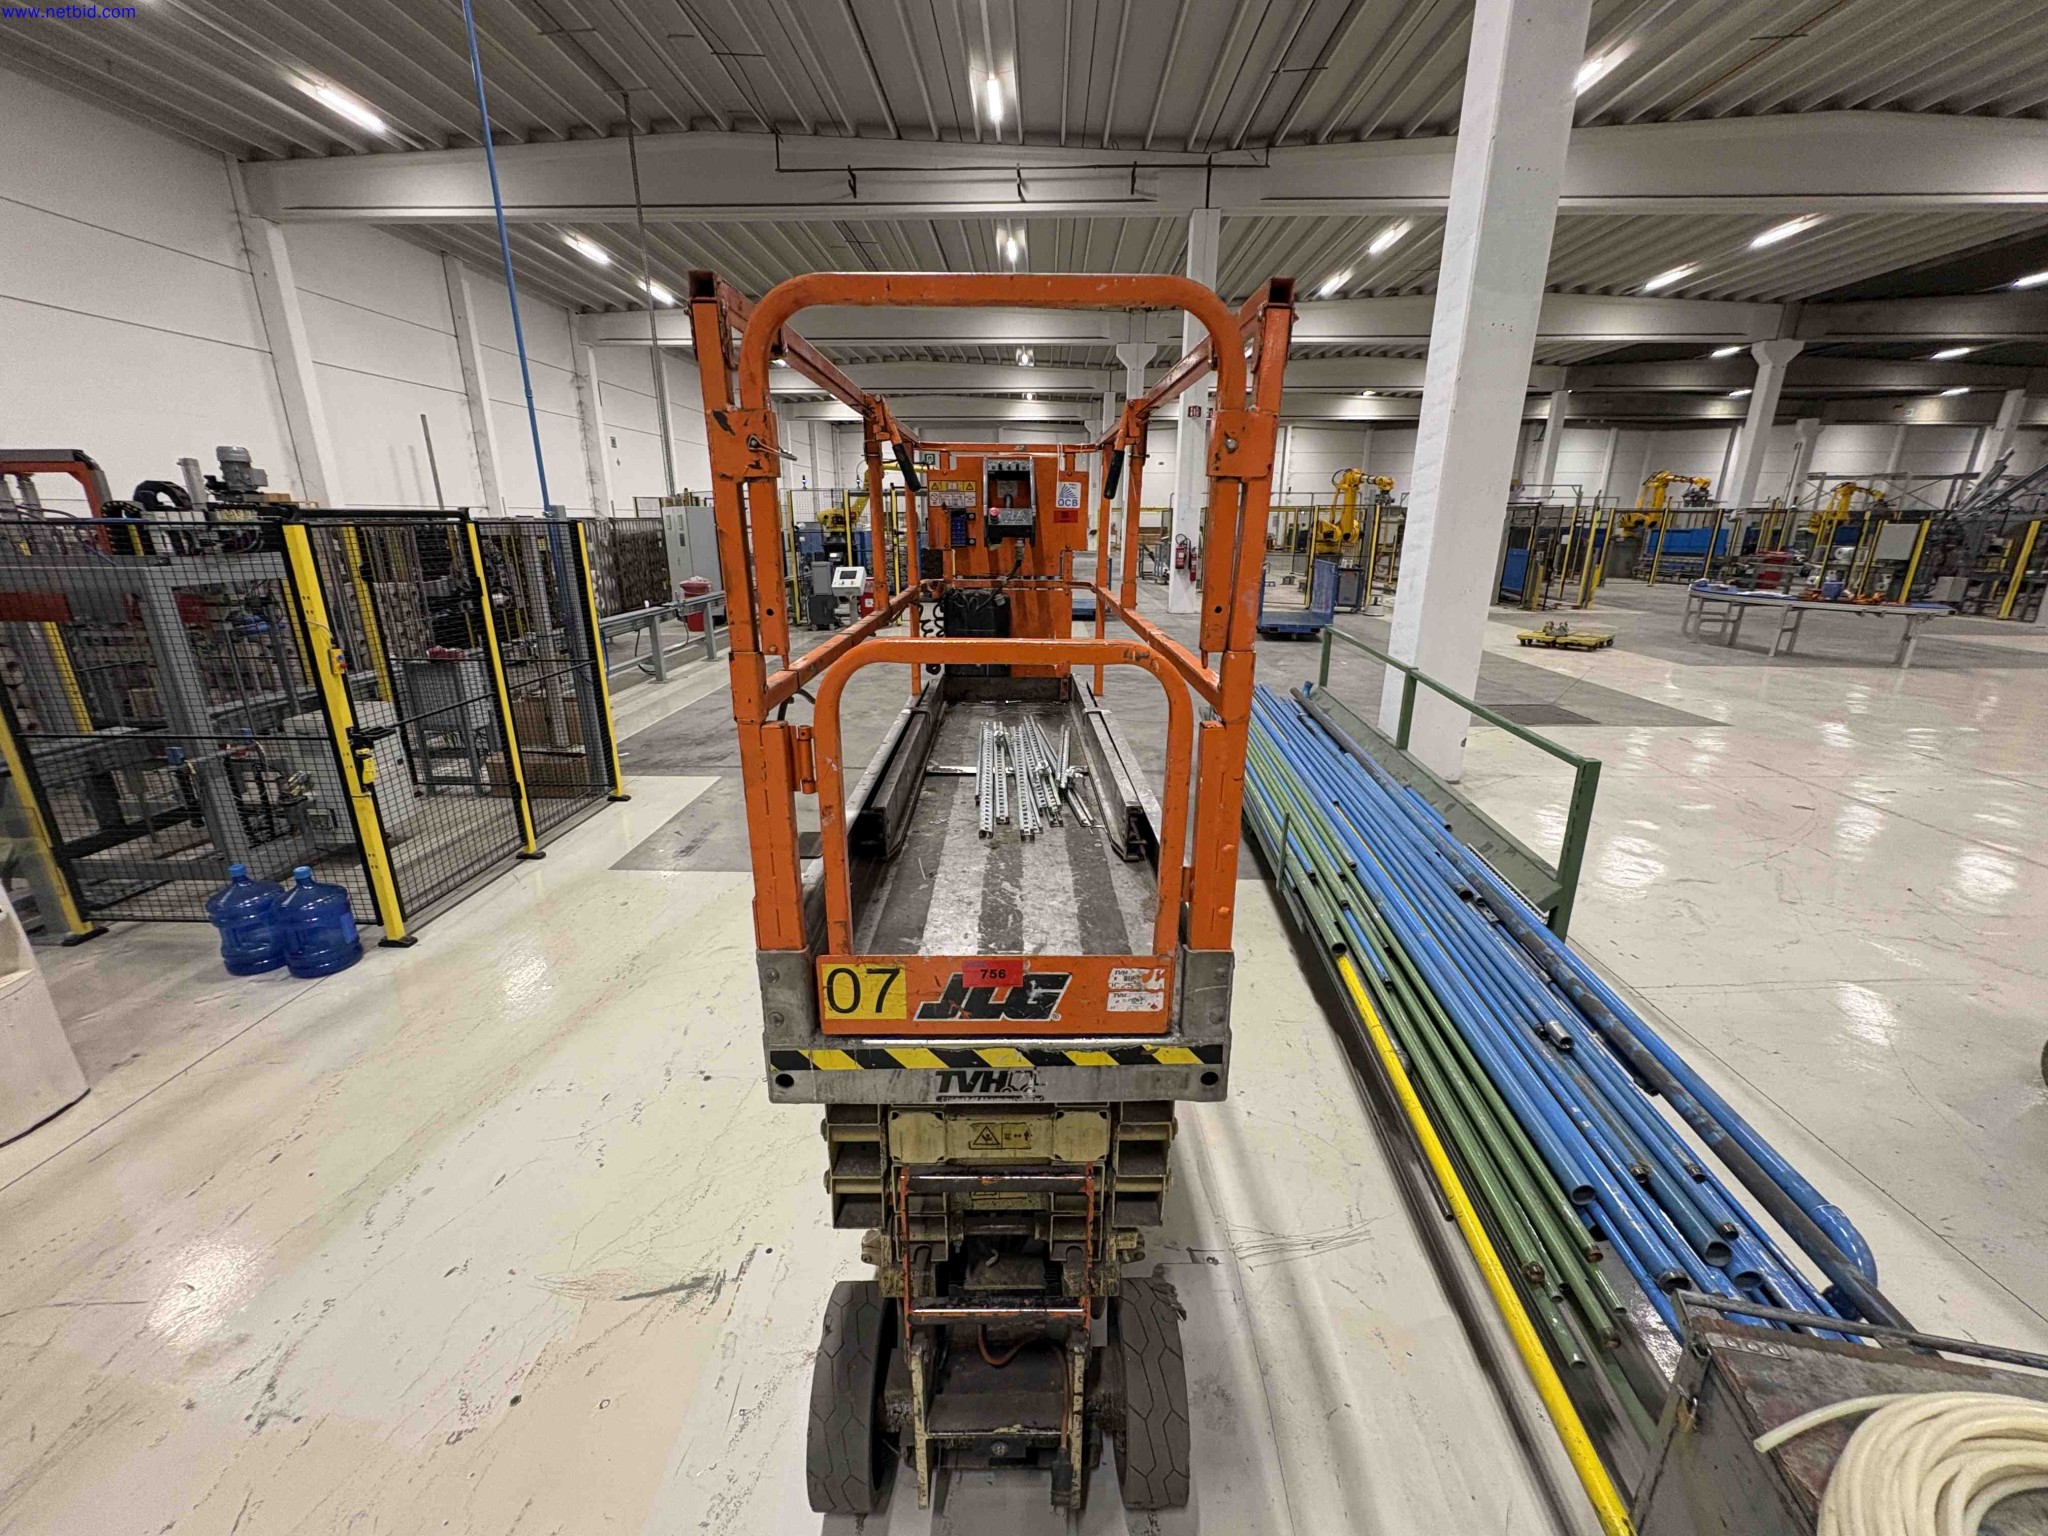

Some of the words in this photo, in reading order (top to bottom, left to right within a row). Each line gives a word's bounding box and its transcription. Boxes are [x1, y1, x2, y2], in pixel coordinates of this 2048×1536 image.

[1057, 499, 1079, 507] OCB
[980, 969, 1007, 980] 756
[826, 967, 901, 1014] 07
[935, 1071, 1009, 1093] TVH
